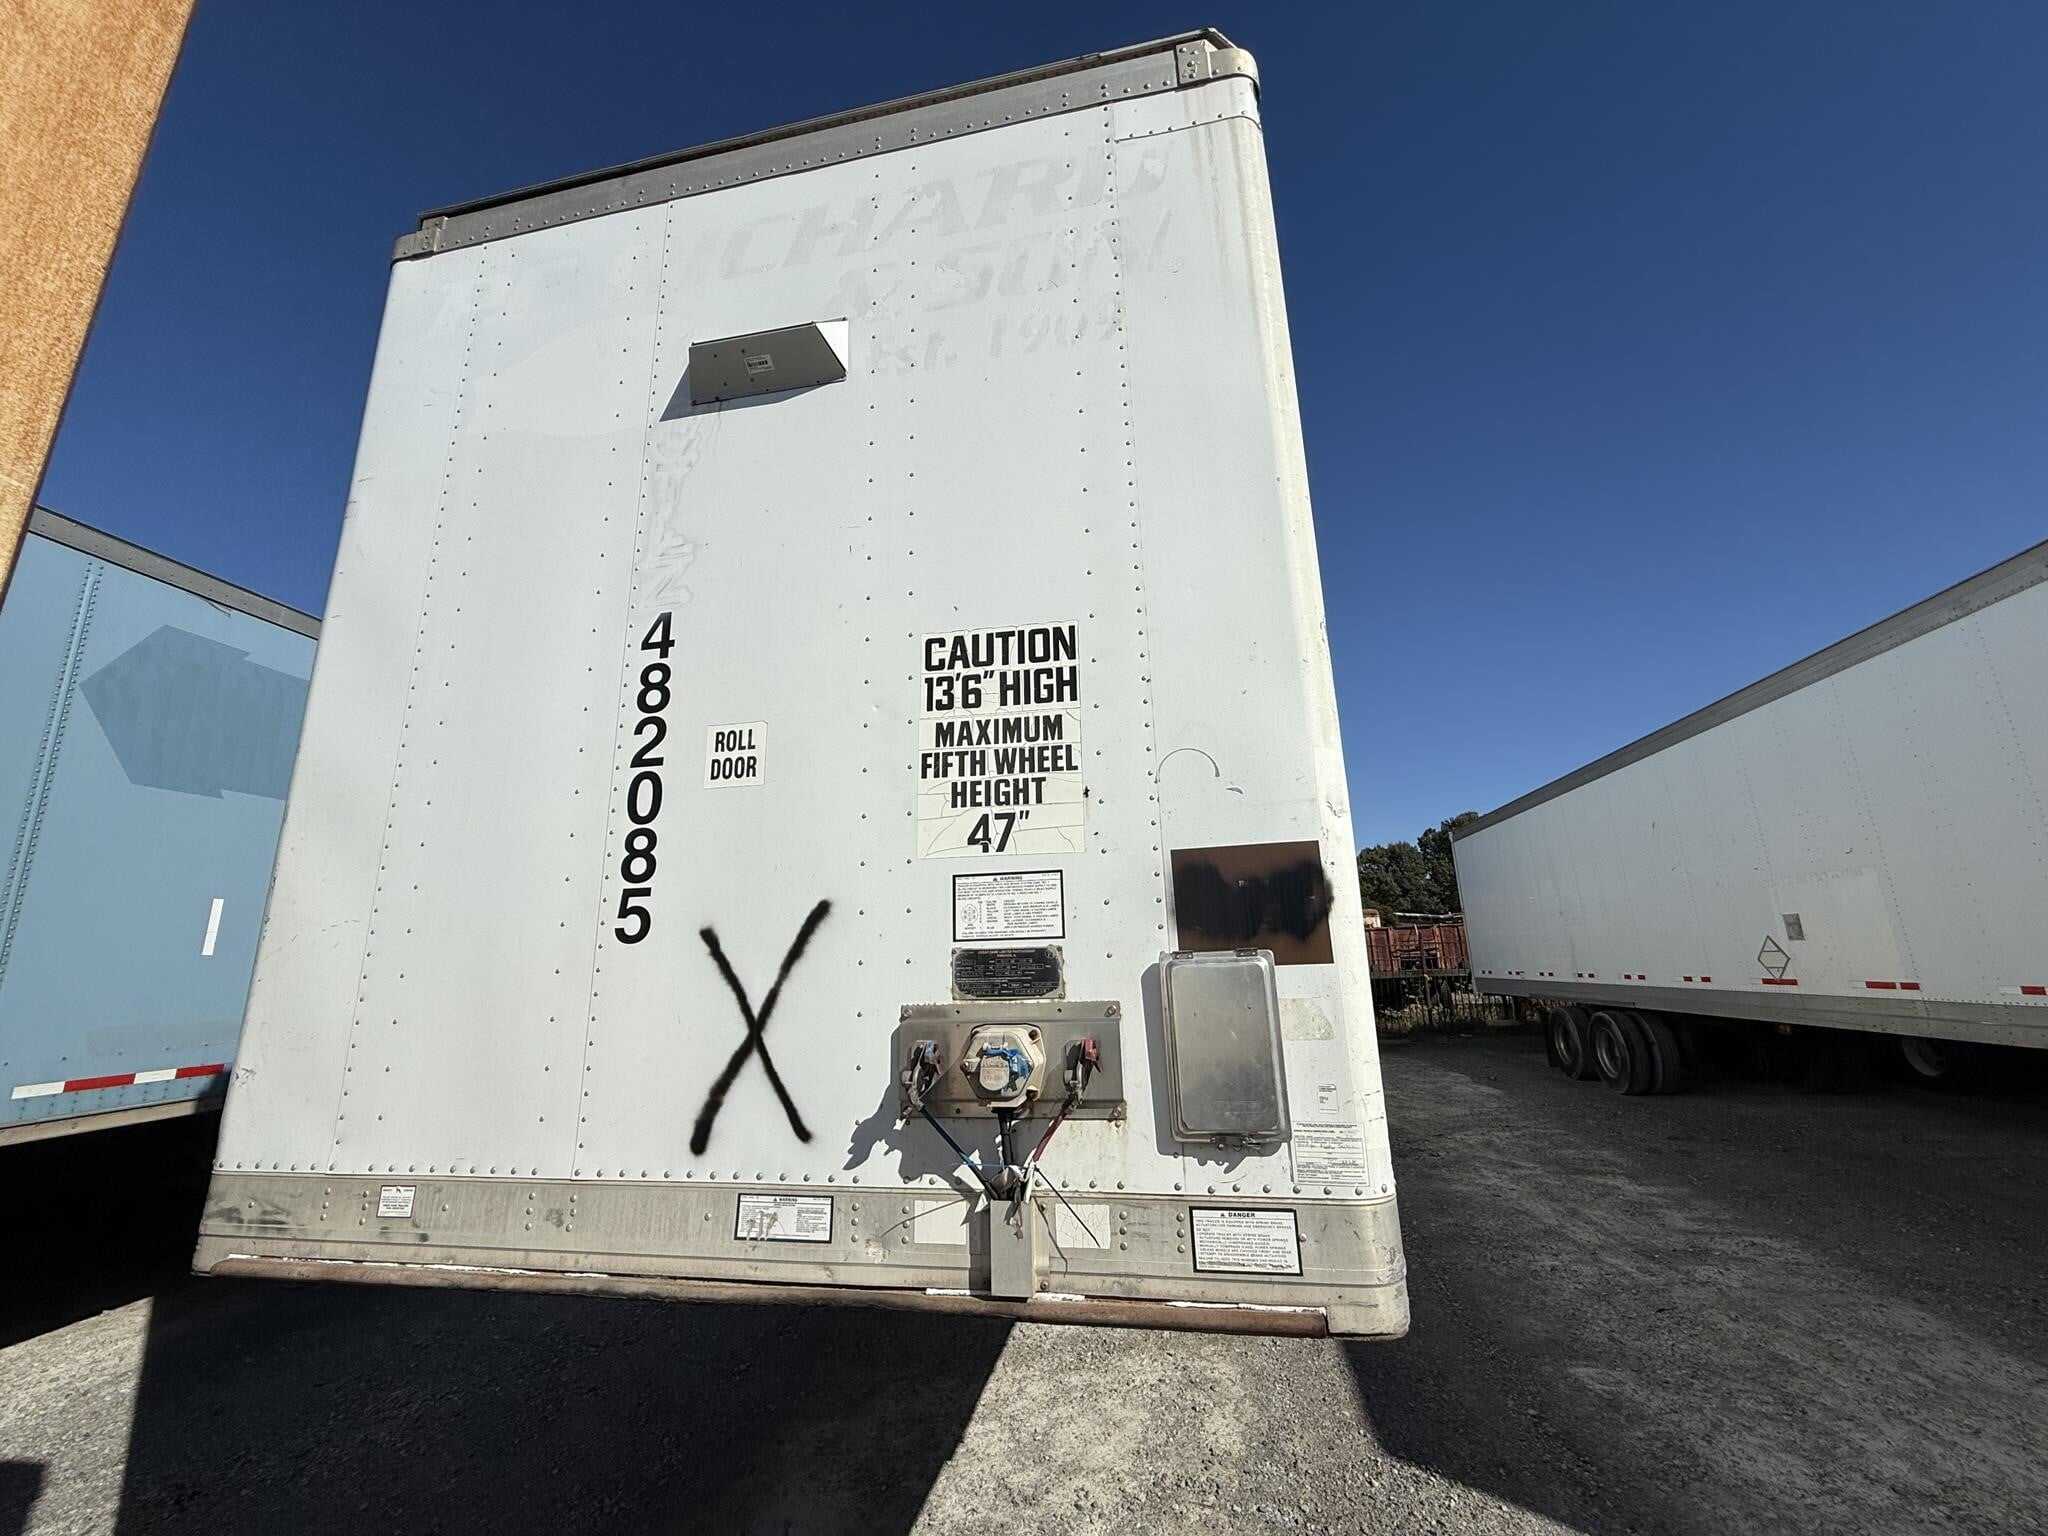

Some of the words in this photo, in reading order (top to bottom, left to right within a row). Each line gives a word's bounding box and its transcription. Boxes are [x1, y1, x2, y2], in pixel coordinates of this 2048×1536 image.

[925, 626, 1077, 672] CAUTION
[999, 665, 1078, 707] HIGH
[714, 728, 756, 753] ROLL
[935, 714, 1063, 748] MAXIMUM
[614, 611, 676, 945] 482085
[710, 755, 757, 781] DOOR
[920, 749, 987, 779] FIFTH
[993, 743, 1079, 775] WHEEL
[951, 776, 1047, 809] HEIGHT
[690, 900, 831, 1156] X
